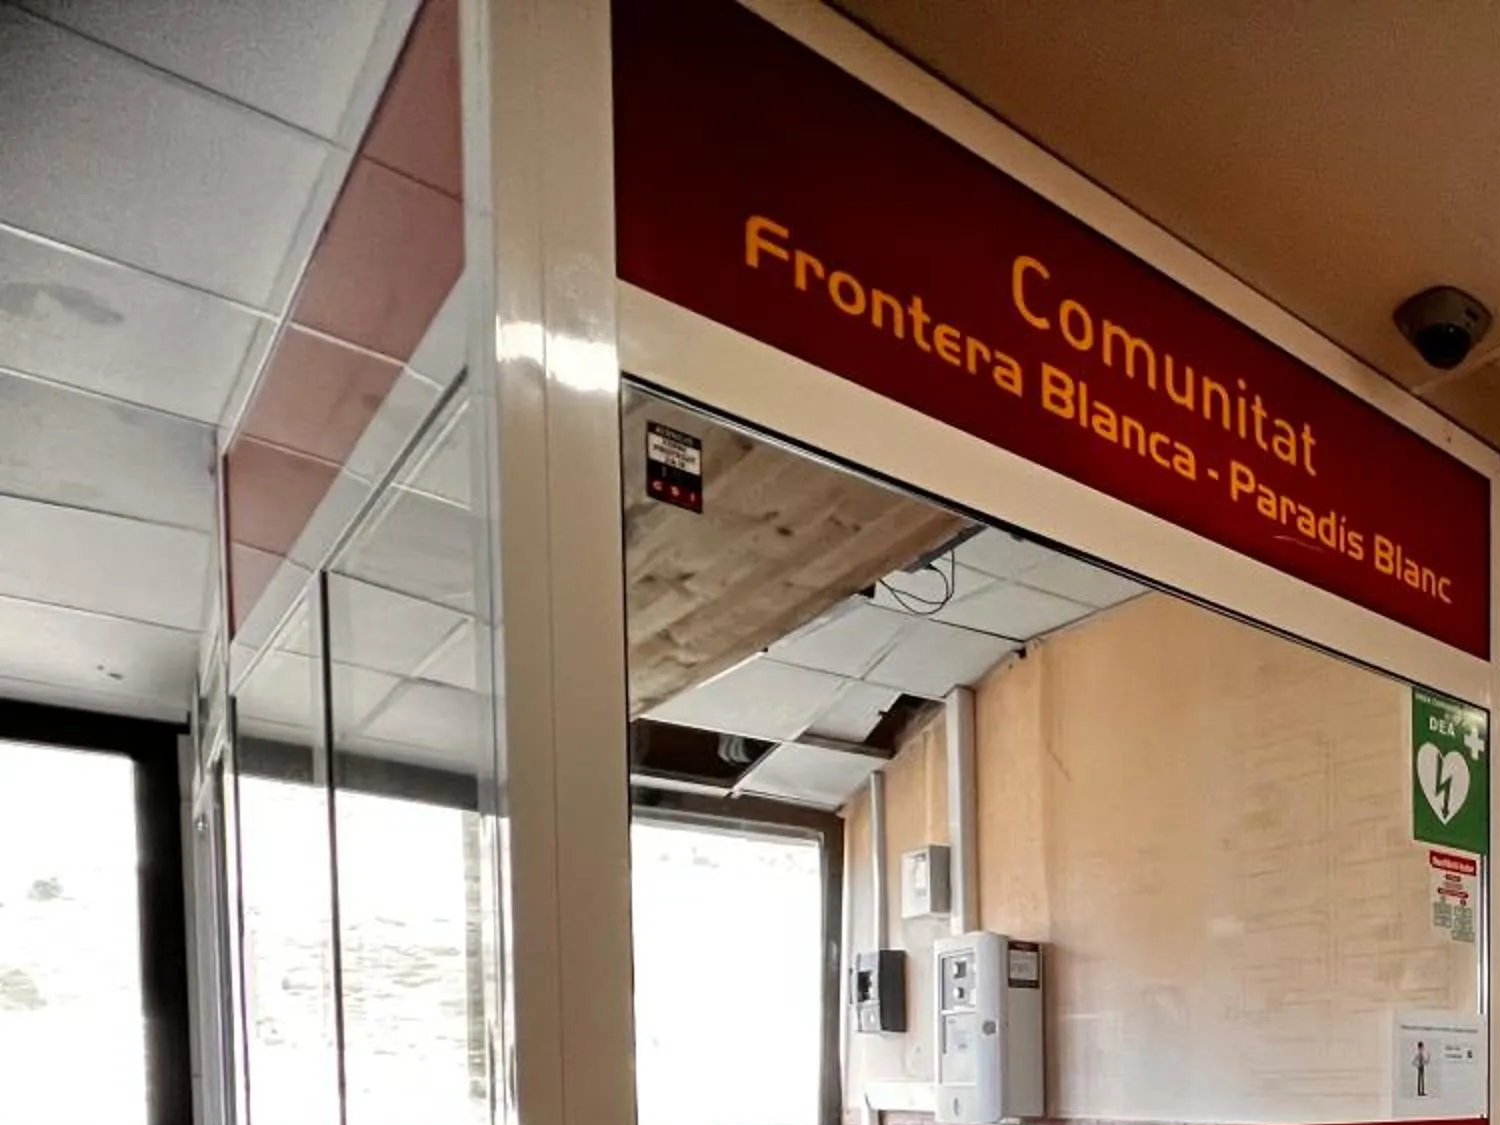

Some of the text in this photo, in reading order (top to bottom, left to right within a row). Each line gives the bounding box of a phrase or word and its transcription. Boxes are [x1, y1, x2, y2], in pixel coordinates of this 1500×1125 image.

[745, 215, 1023, 398] Frontera
[1041, 361, 1197, 481] Blanca
[1230, 460, 1365, 561] Paradís
[1373, 534, 1453, 605] Blanc
[1012, 255, 1318, 477] Comunitat
[1429, 715, 1456, 738] DEA
